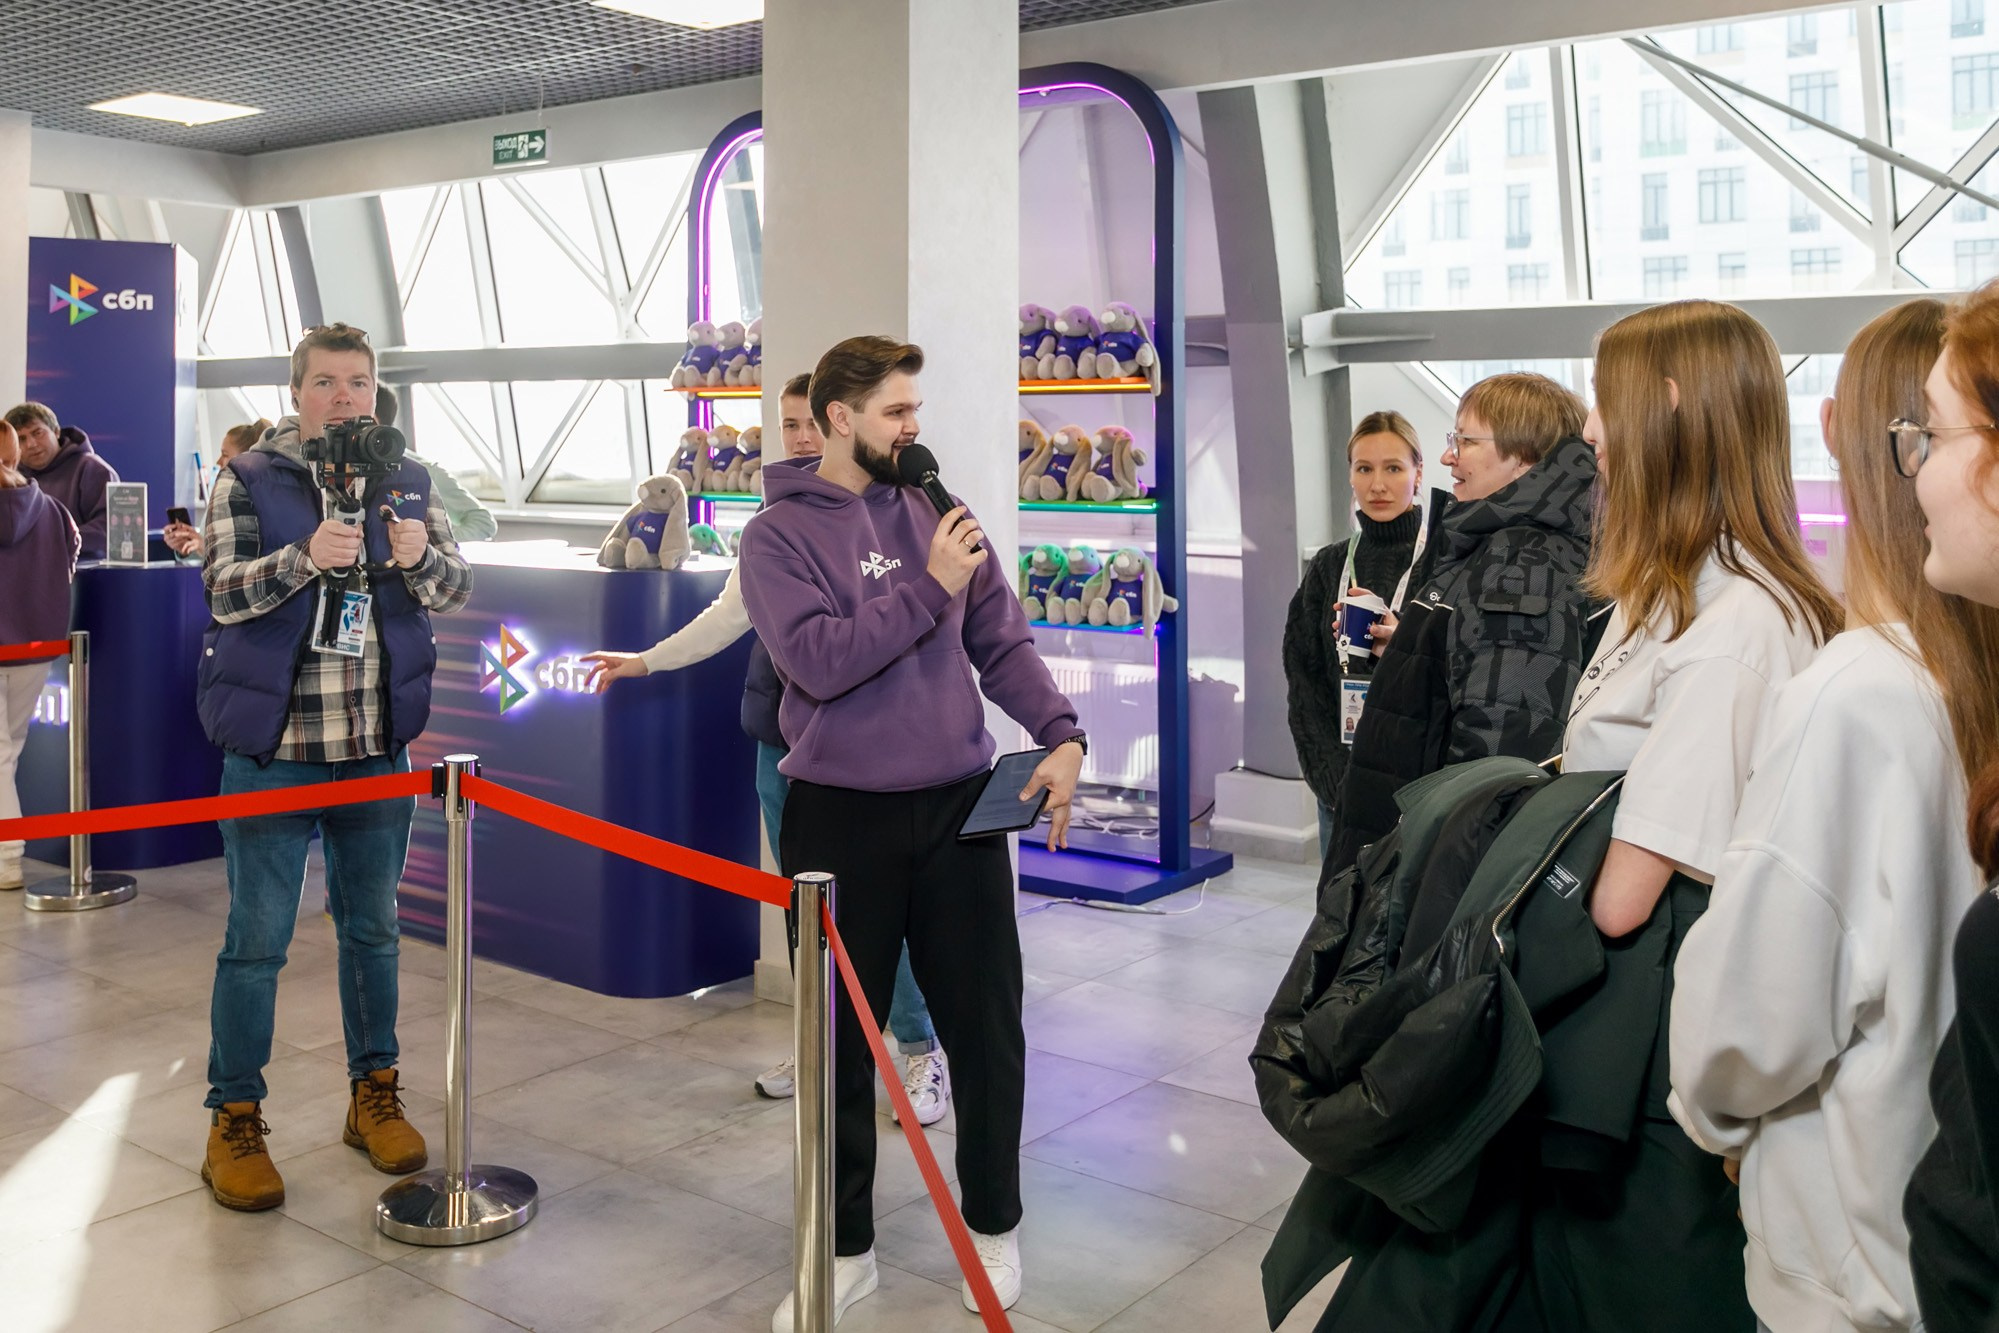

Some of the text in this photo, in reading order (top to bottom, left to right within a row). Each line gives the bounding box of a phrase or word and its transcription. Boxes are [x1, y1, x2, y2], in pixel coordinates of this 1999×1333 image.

[499, 150, 513, 160] EXIT
[102, 289, 154, 311] сбп
[404, 492, 421, 501] сбп
[884, 558, 902, 571] бп
[533, 655, 591, 694] сбп
